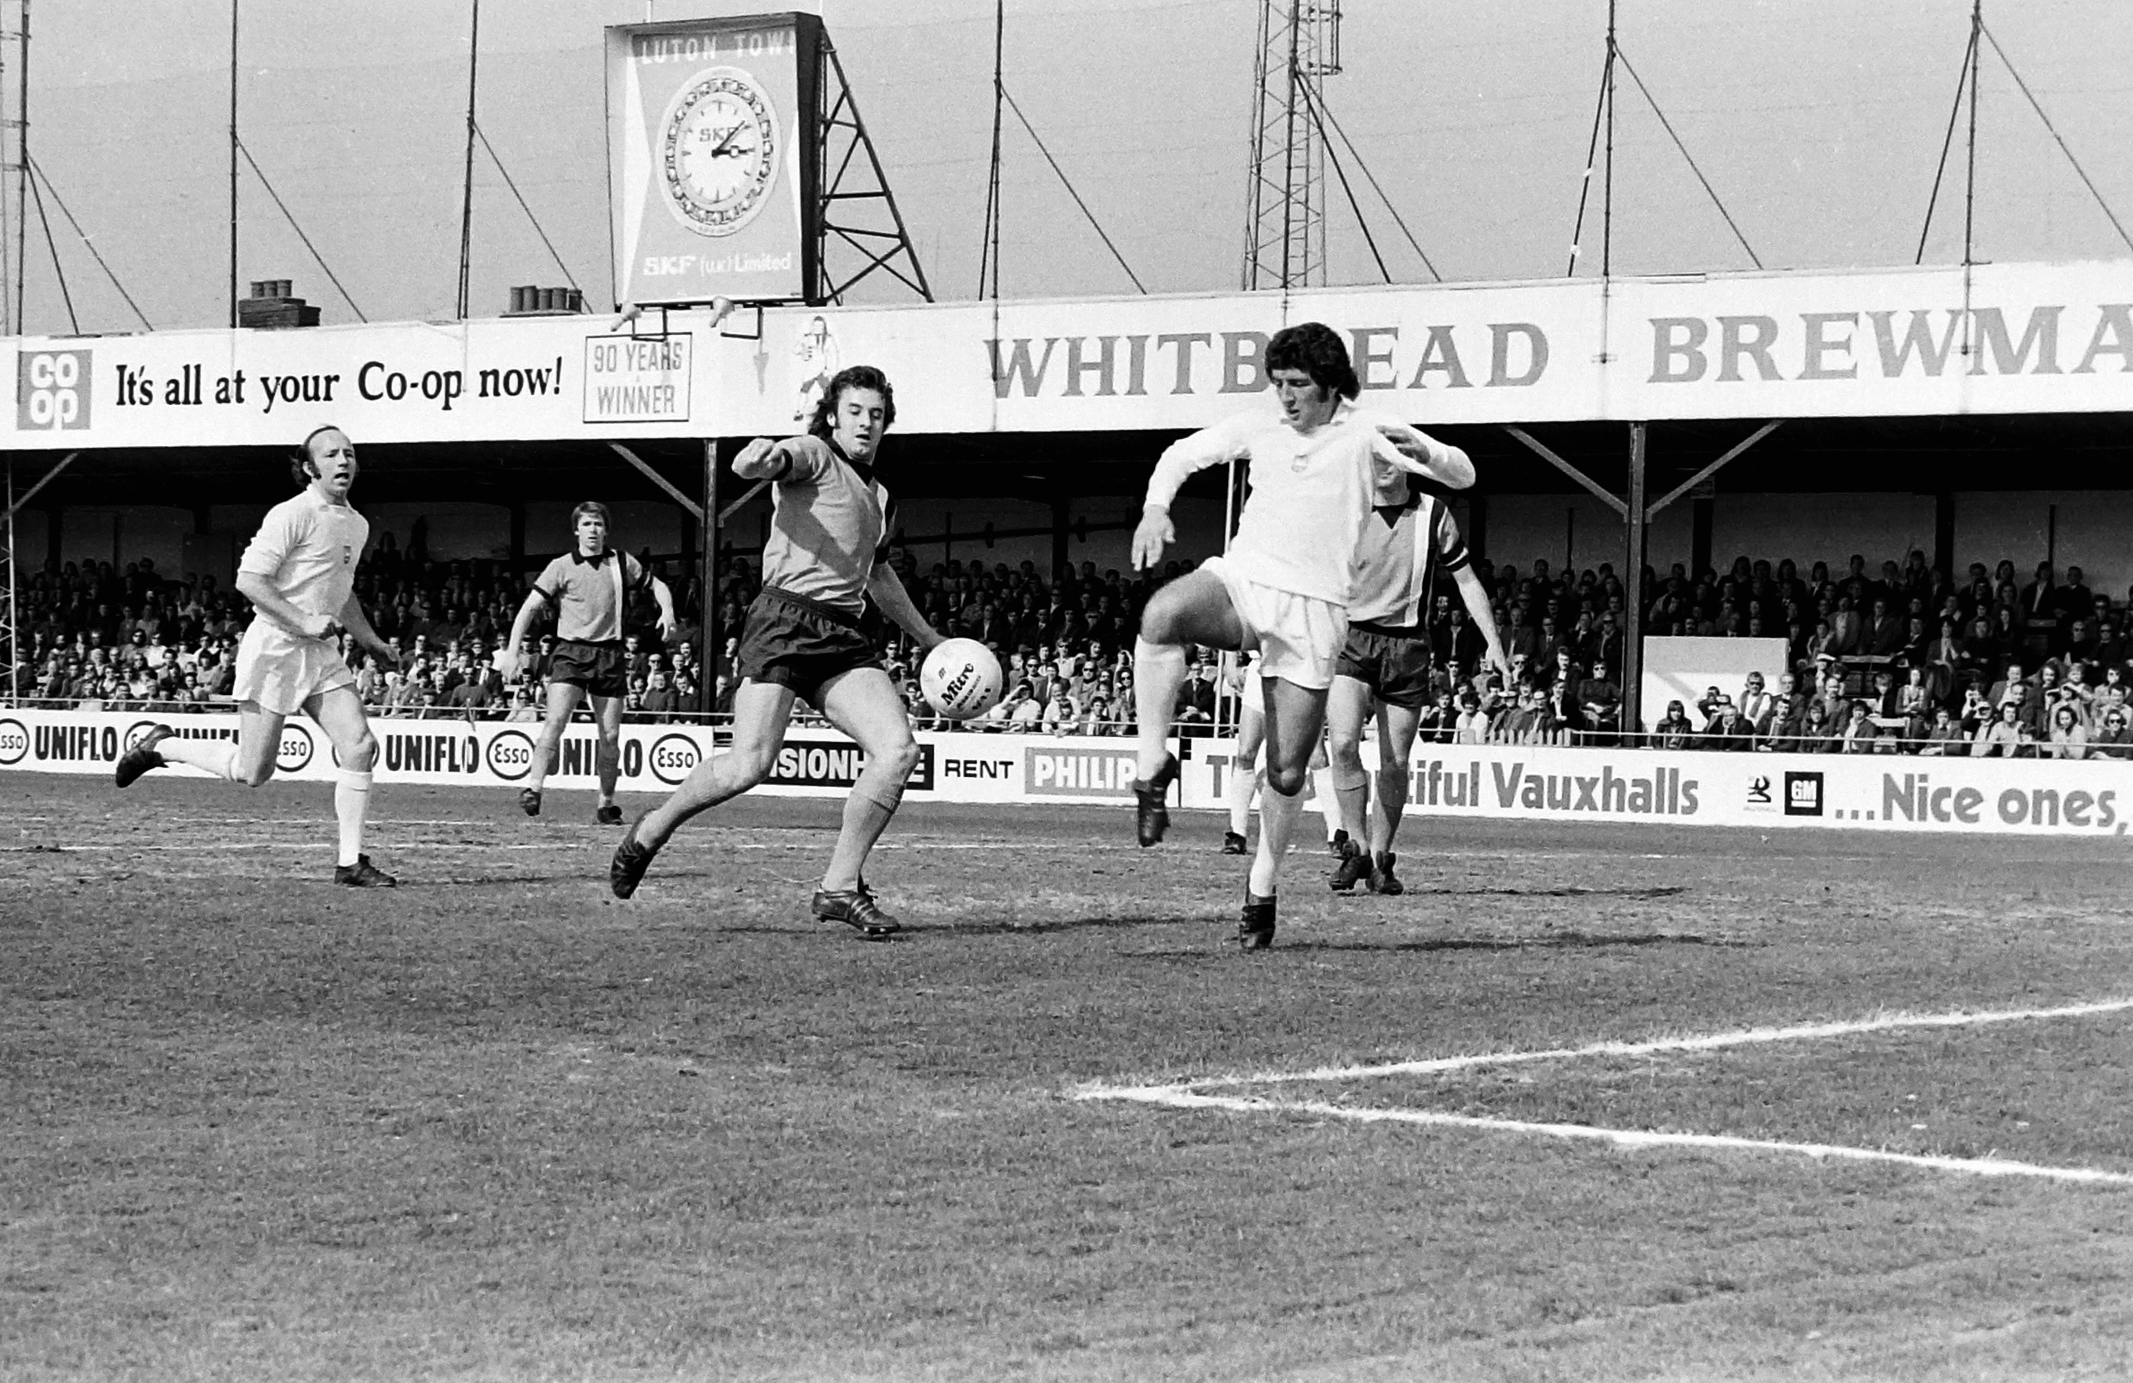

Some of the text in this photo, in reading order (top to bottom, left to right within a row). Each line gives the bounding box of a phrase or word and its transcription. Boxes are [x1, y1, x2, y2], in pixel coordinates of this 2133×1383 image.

[641, 35, 717, 65] LUTON
[643, 255, 696, 276] SKF
[735, 251, 791, 272] Limited
[594, 341, 683, 373] 90 YEARS
[982, 322, 1549, 400] WHITBEAD
[116, 356, 563, 414] It's all at your Co-op now!
[597, 385, 675, 415] WINNER
[941, 663, 974, 706] Mitre
[35, 725, 118, 762] UNIFLO
[385, 734, 480, 774] UNIFLO
[945, 758, 1014, 780] RENT
[1034, 755, 1138, 790] PHILIP
[1491, 762, 1699, 815] Vauxhalls
[1790, 779, 1817, 801] GM
